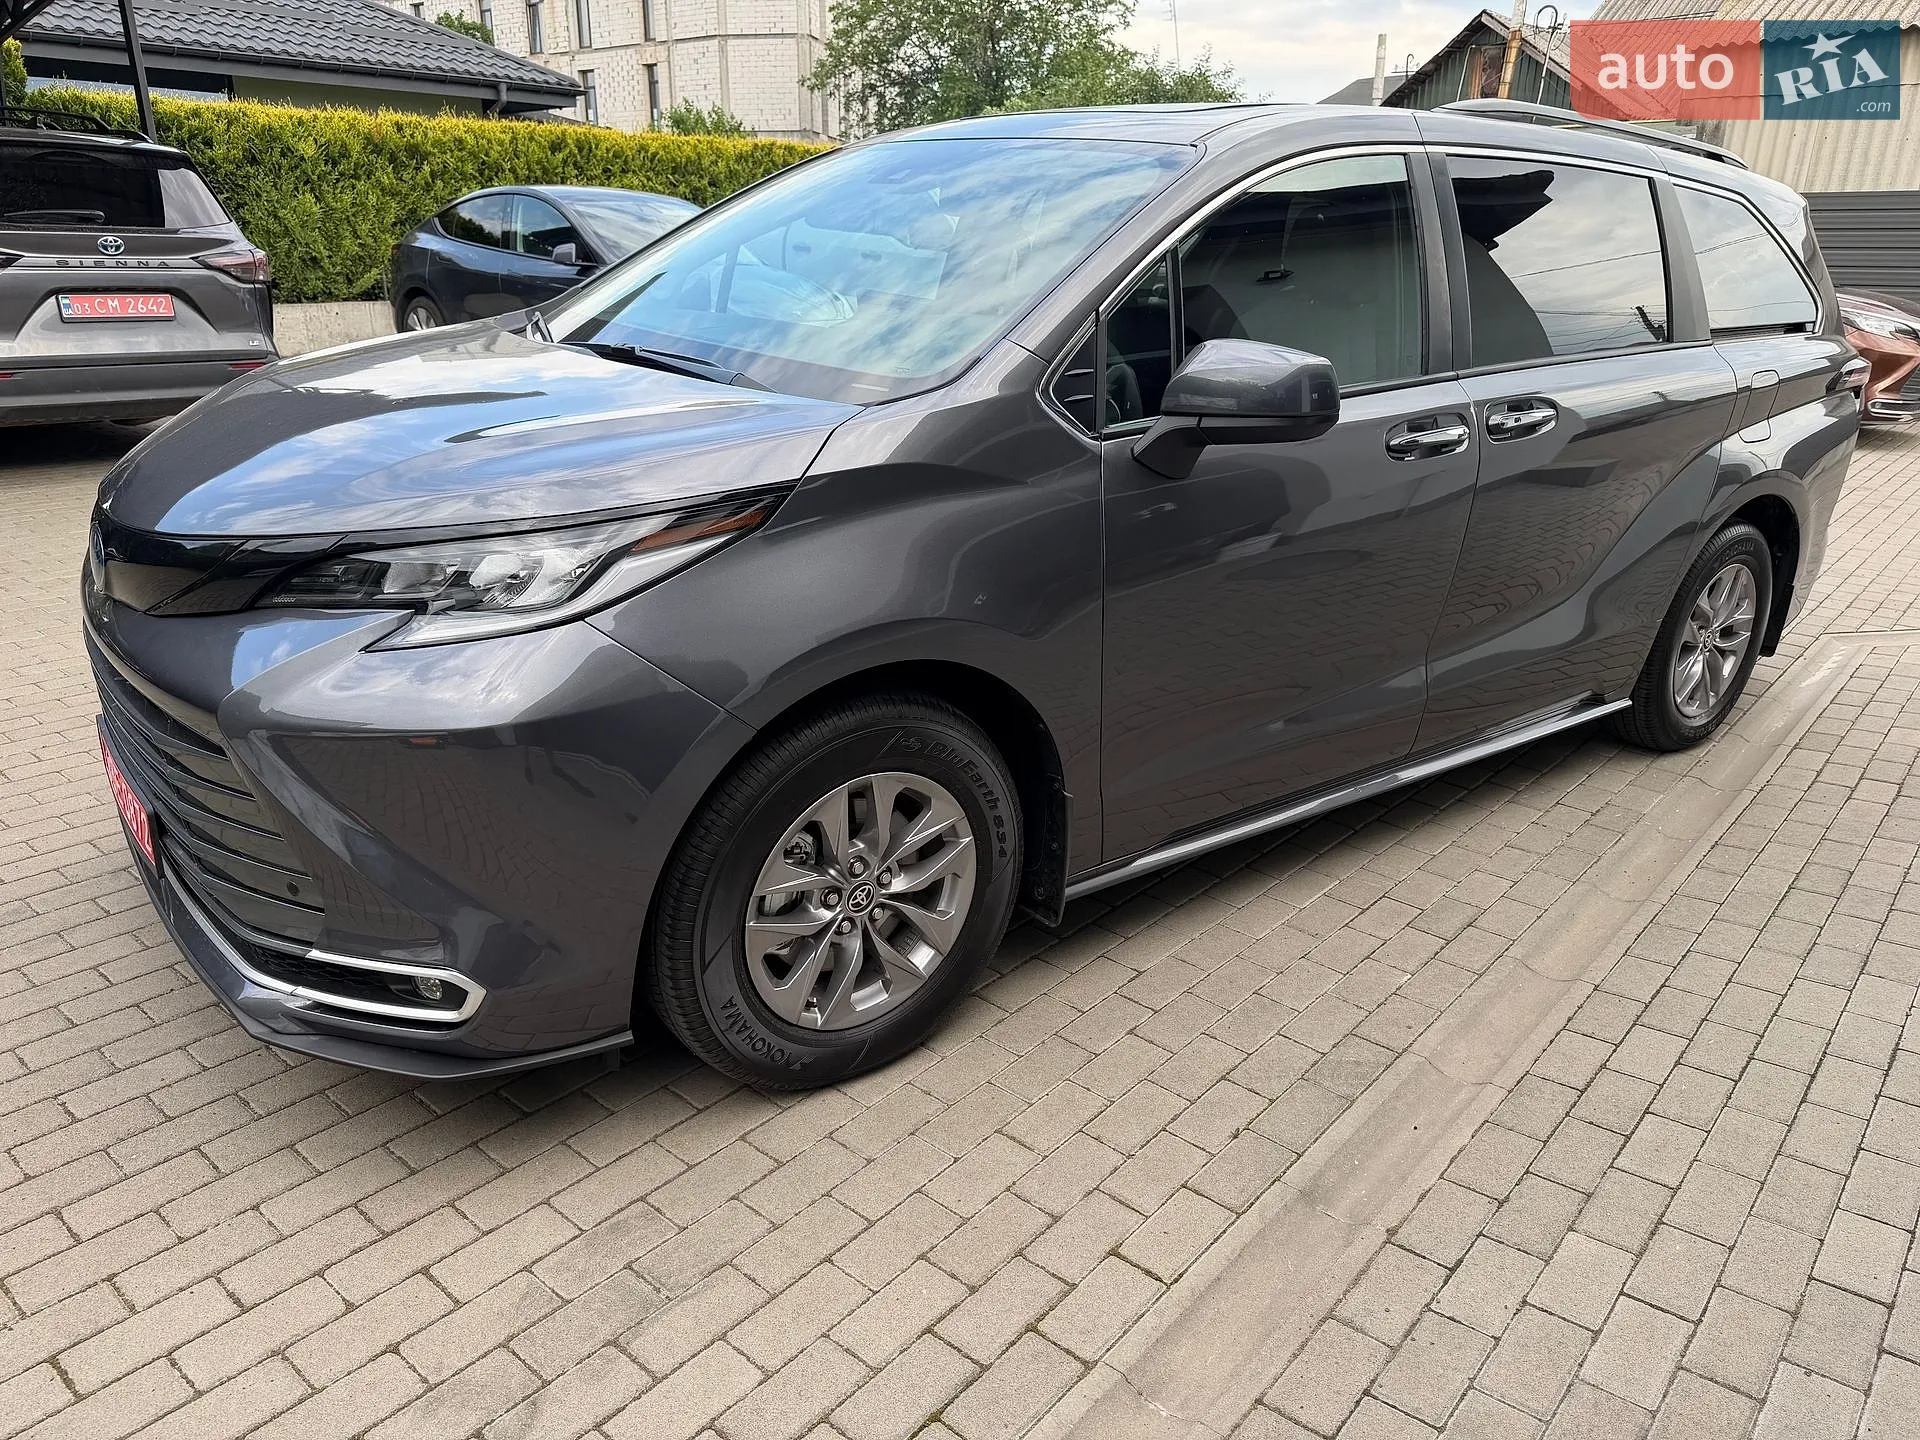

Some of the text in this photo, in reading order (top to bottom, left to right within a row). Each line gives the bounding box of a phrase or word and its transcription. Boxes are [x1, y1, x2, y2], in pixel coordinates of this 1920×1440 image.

[56, 259, 169, 268] SIENNA
[74, 297, 169, 316] 03 CM 2642
[720, 995, 793, 1067] YOKOHAMA
